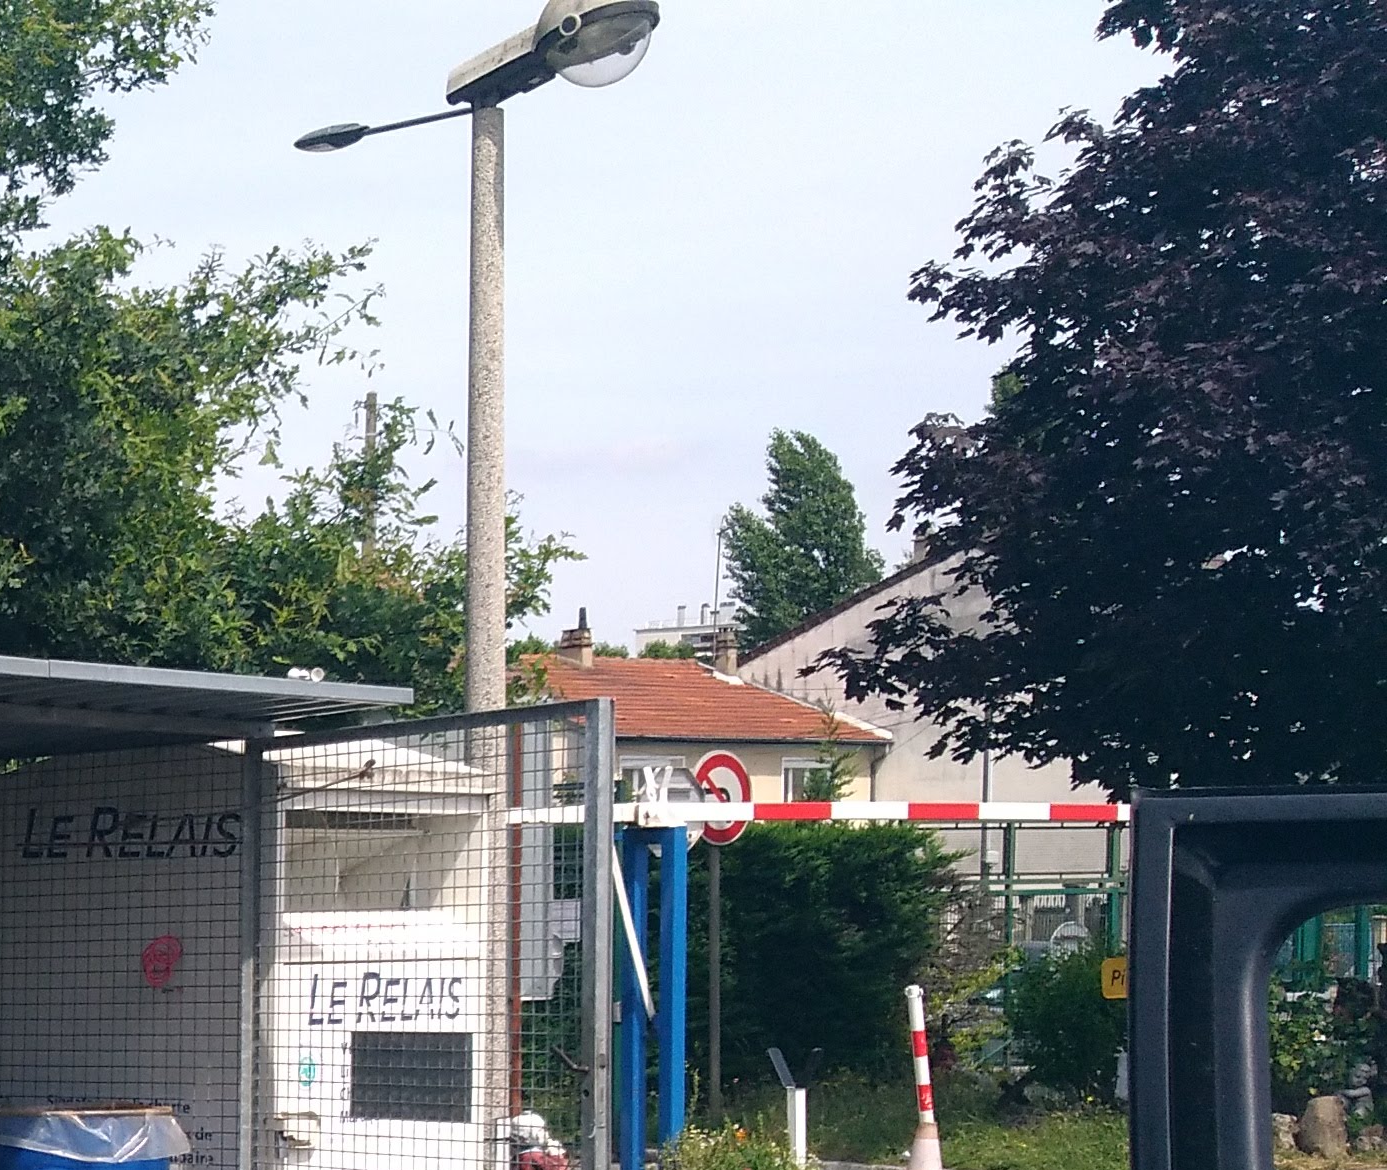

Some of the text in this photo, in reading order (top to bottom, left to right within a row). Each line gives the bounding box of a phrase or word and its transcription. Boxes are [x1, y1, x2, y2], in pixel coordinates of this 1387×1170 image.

[22, 806, 243, 859] LE RELAIS
[307, 971, 463, 1026] LE RELAIS
[1111, 968, 1125, 987] Pi
